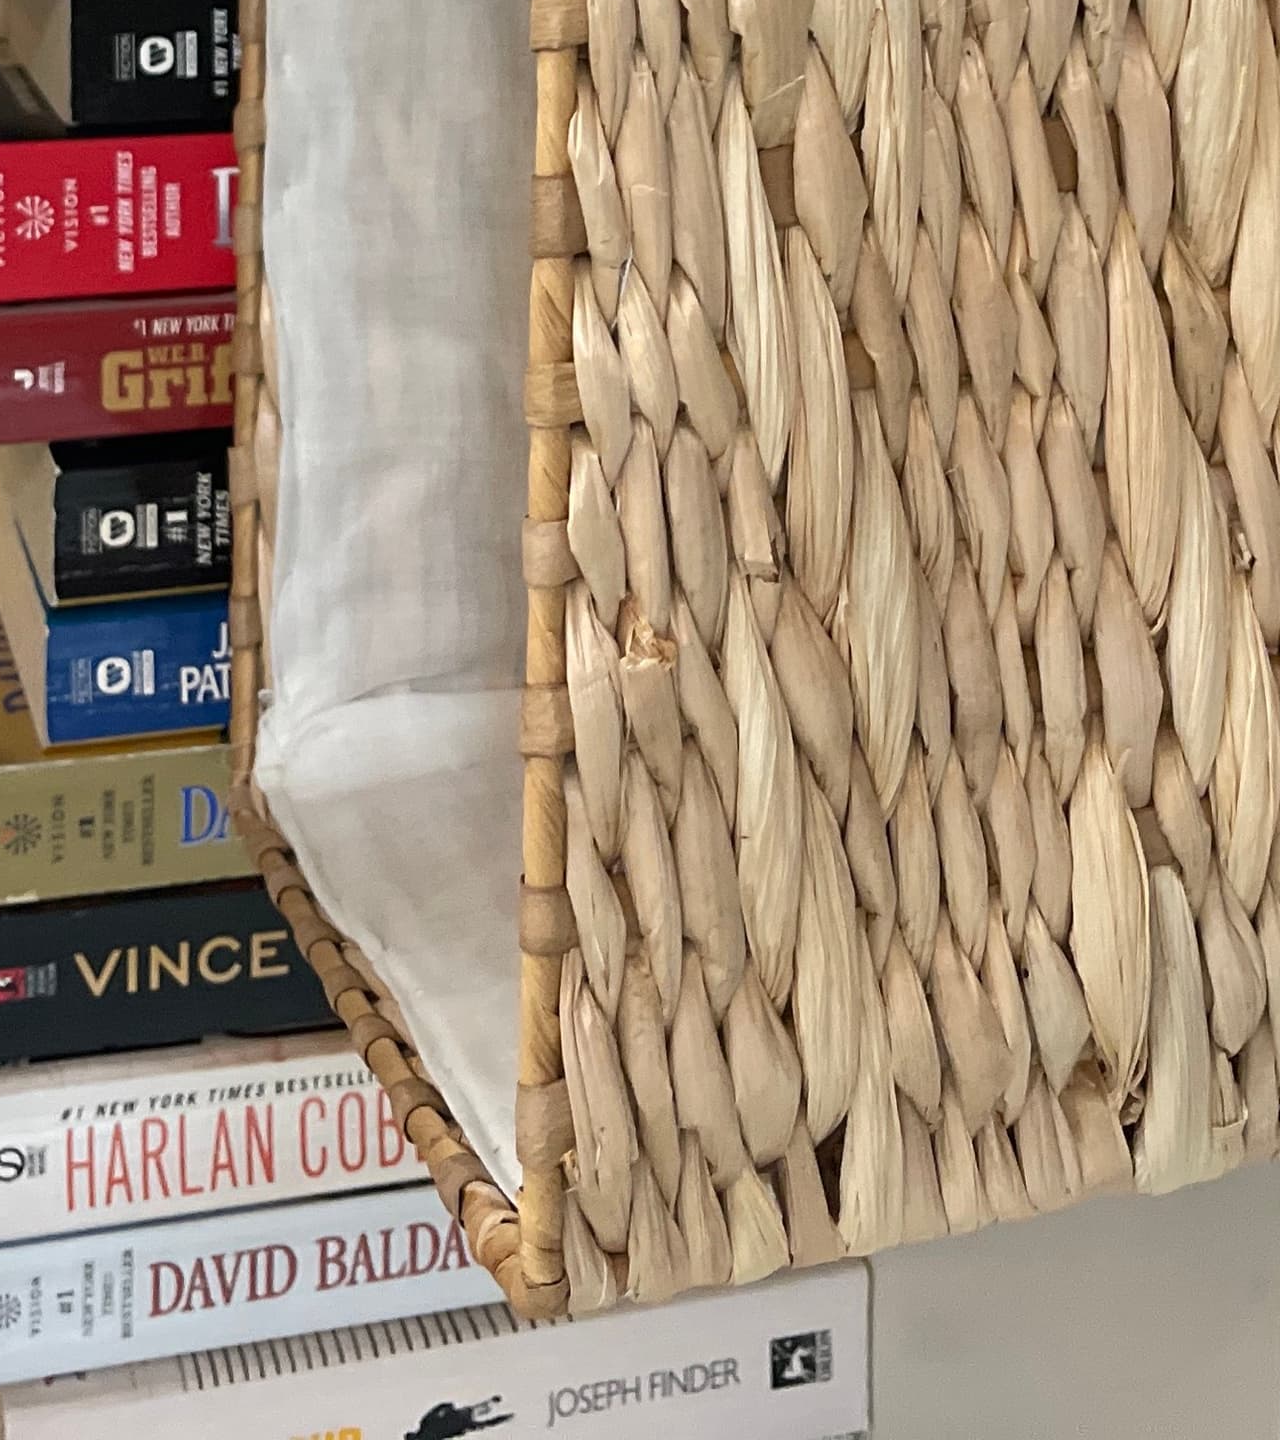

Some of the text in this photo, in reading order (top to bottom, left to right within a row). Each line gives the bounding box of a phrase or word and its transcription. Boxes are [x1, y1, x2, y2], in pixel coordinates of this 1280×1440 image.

[64, 178, 78, 252] VISION
[118, 238, 134, 272] NEW
[153, 316, 182, 336] NEW
[186, 314, 219, 334] YORK
[101, 343, 234, 412] Grif
[166, 511, 188, 543] #1
[196, 472, 213, 566] NEW YORK
[215, 489, 230, 547] TIMES
[180, 663, 232, 704] PAT
[75, 930, 291, 998] VINCE
[62, 1070, 376, 1121] #1 NEW YORK TIMES BESTSELLI
[65, 1086, 410, 1211] HARLAN COB
[149, 1220, 472, 1318] DAVID BALDA
[57, 1289, 74, 1314] #1
[545, 1358, 741, 1427] JOSEPH FINDER
